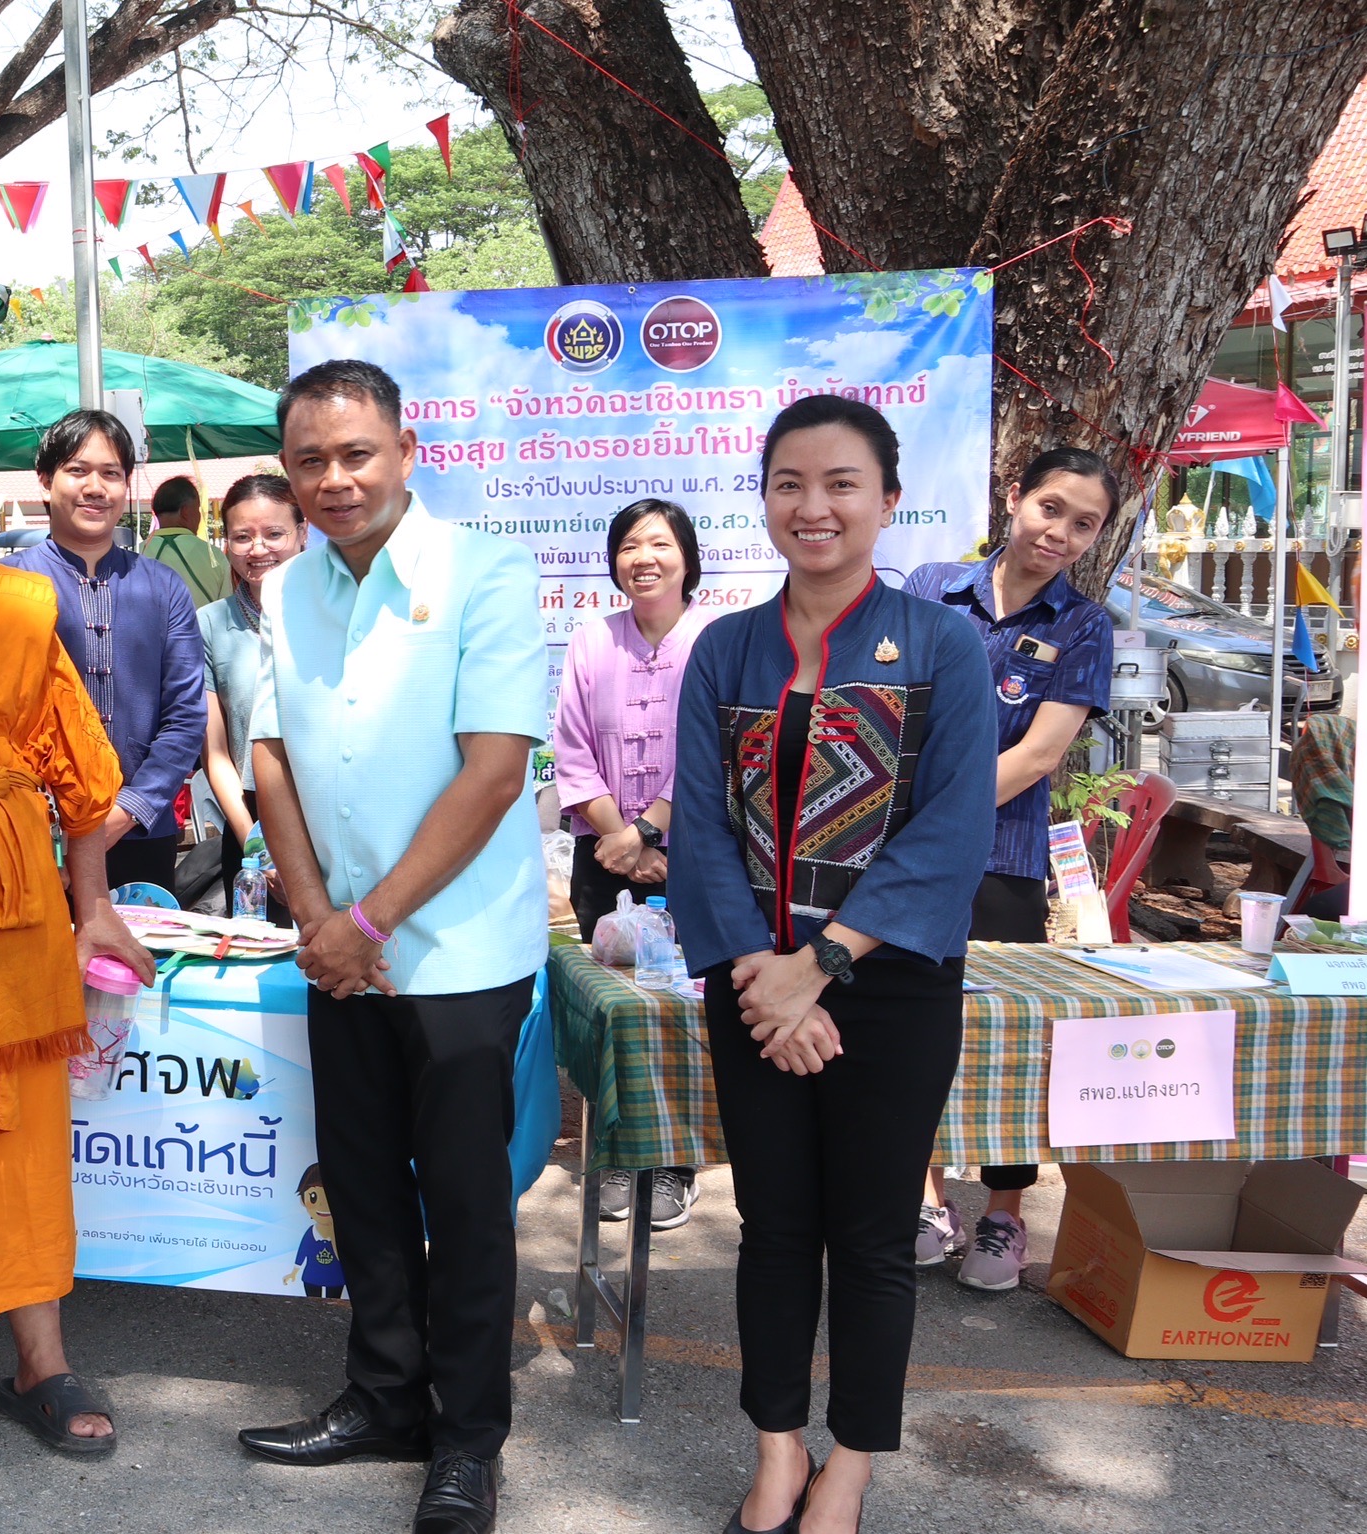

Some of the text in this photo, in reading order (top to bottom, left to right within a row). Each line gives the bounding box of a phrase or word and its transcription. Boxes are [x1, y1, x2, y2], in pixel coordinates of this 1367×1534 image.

[649, 321, 713, 340] OTOP
[401, 399, 476, 420] งการ
[490, 384, 763, 417] “จังหวัดฉะเชิงเทรา
[1174, 431, 1241, 442] YFRIEND
[485, 474, 761, 498] ประจำปีงบประมาณ พ.ศ. 25
[573, 591, 600, 609] 24
[698, 588, 753, 606] 2567
[1079, 1081, 1200, 1101] สพอ.แปลงยาว
[82, 1229, 266, 1253] ลดรายจ่าย เพิ่มรายได้ มีเงินออม
[1161, 1330, 1291, 1347] EARTHONZEN
